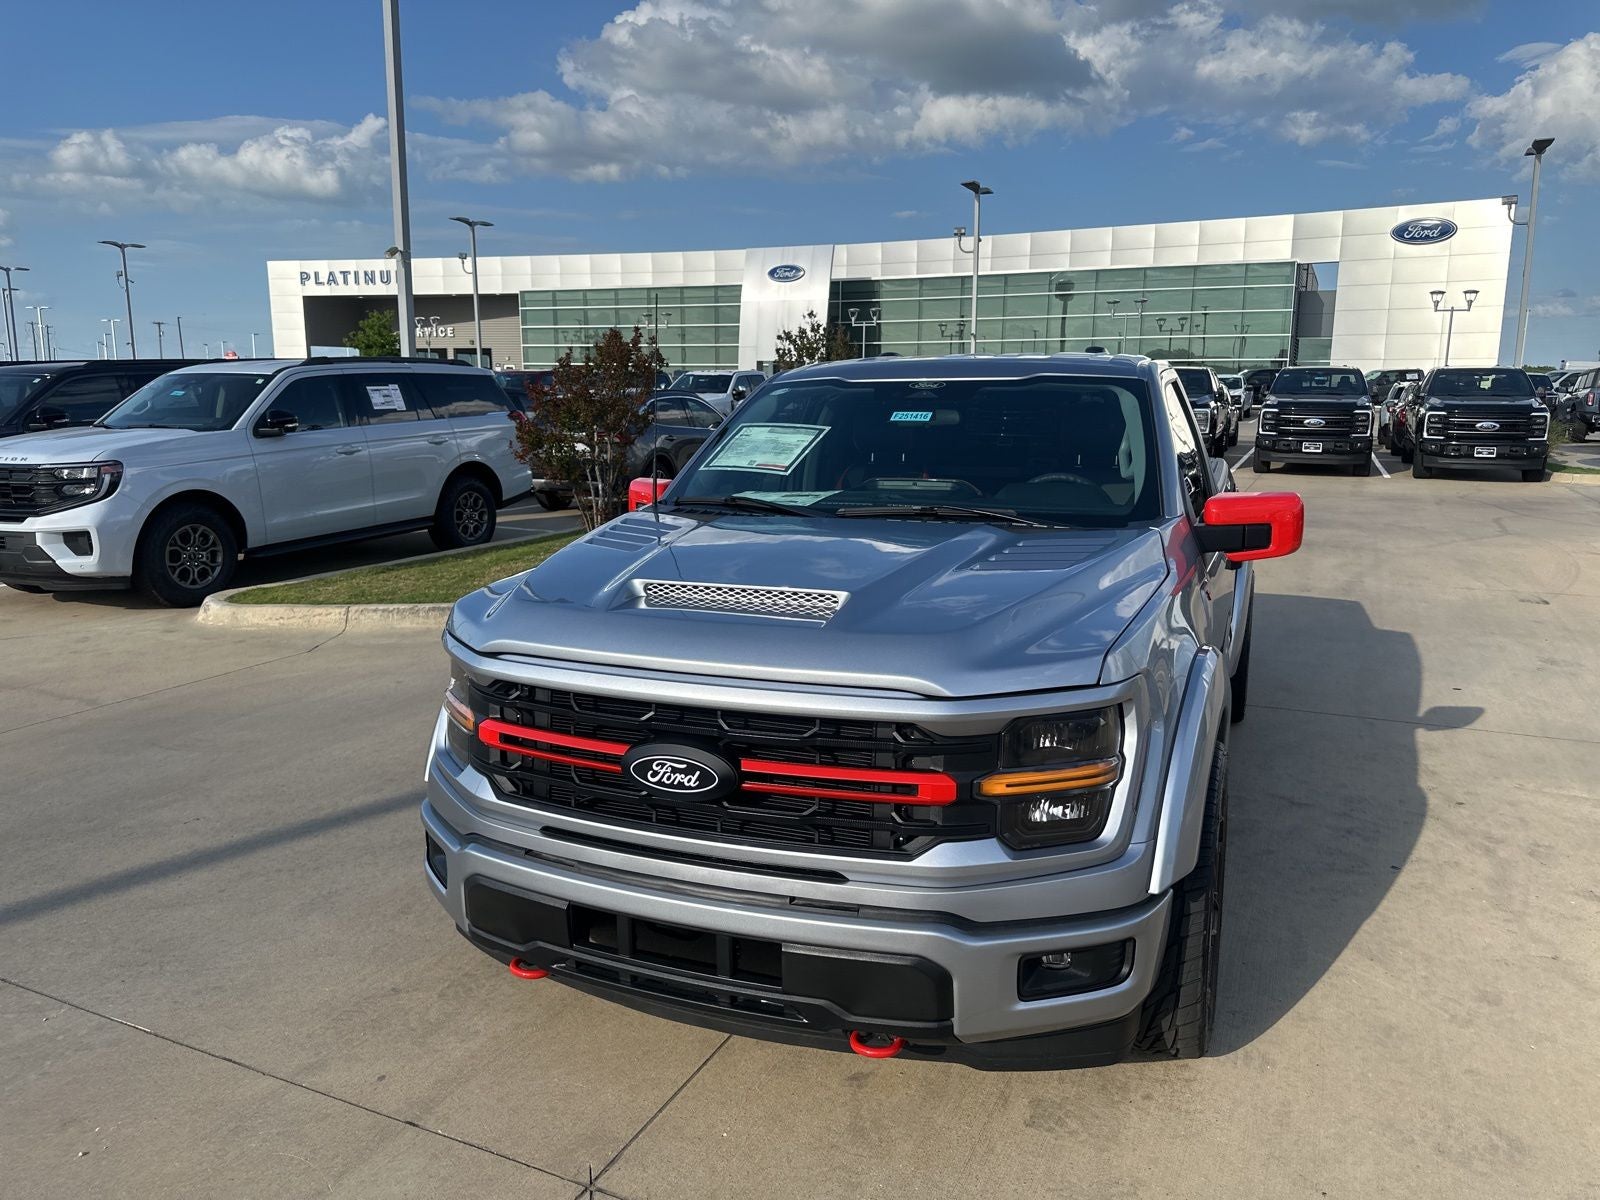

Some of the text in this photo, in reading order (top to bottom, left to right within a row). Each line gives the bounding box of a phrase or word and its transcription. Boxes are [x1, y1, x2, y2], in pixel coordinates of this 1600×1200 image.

[1403, 224, 1440, 238] Ford
[299, 270, 398, 286] PLATINU
[774, 267, 796, 278] Ford
[893, 412, 930, 420] F251416
[647, 759, 701, 788] Ford
